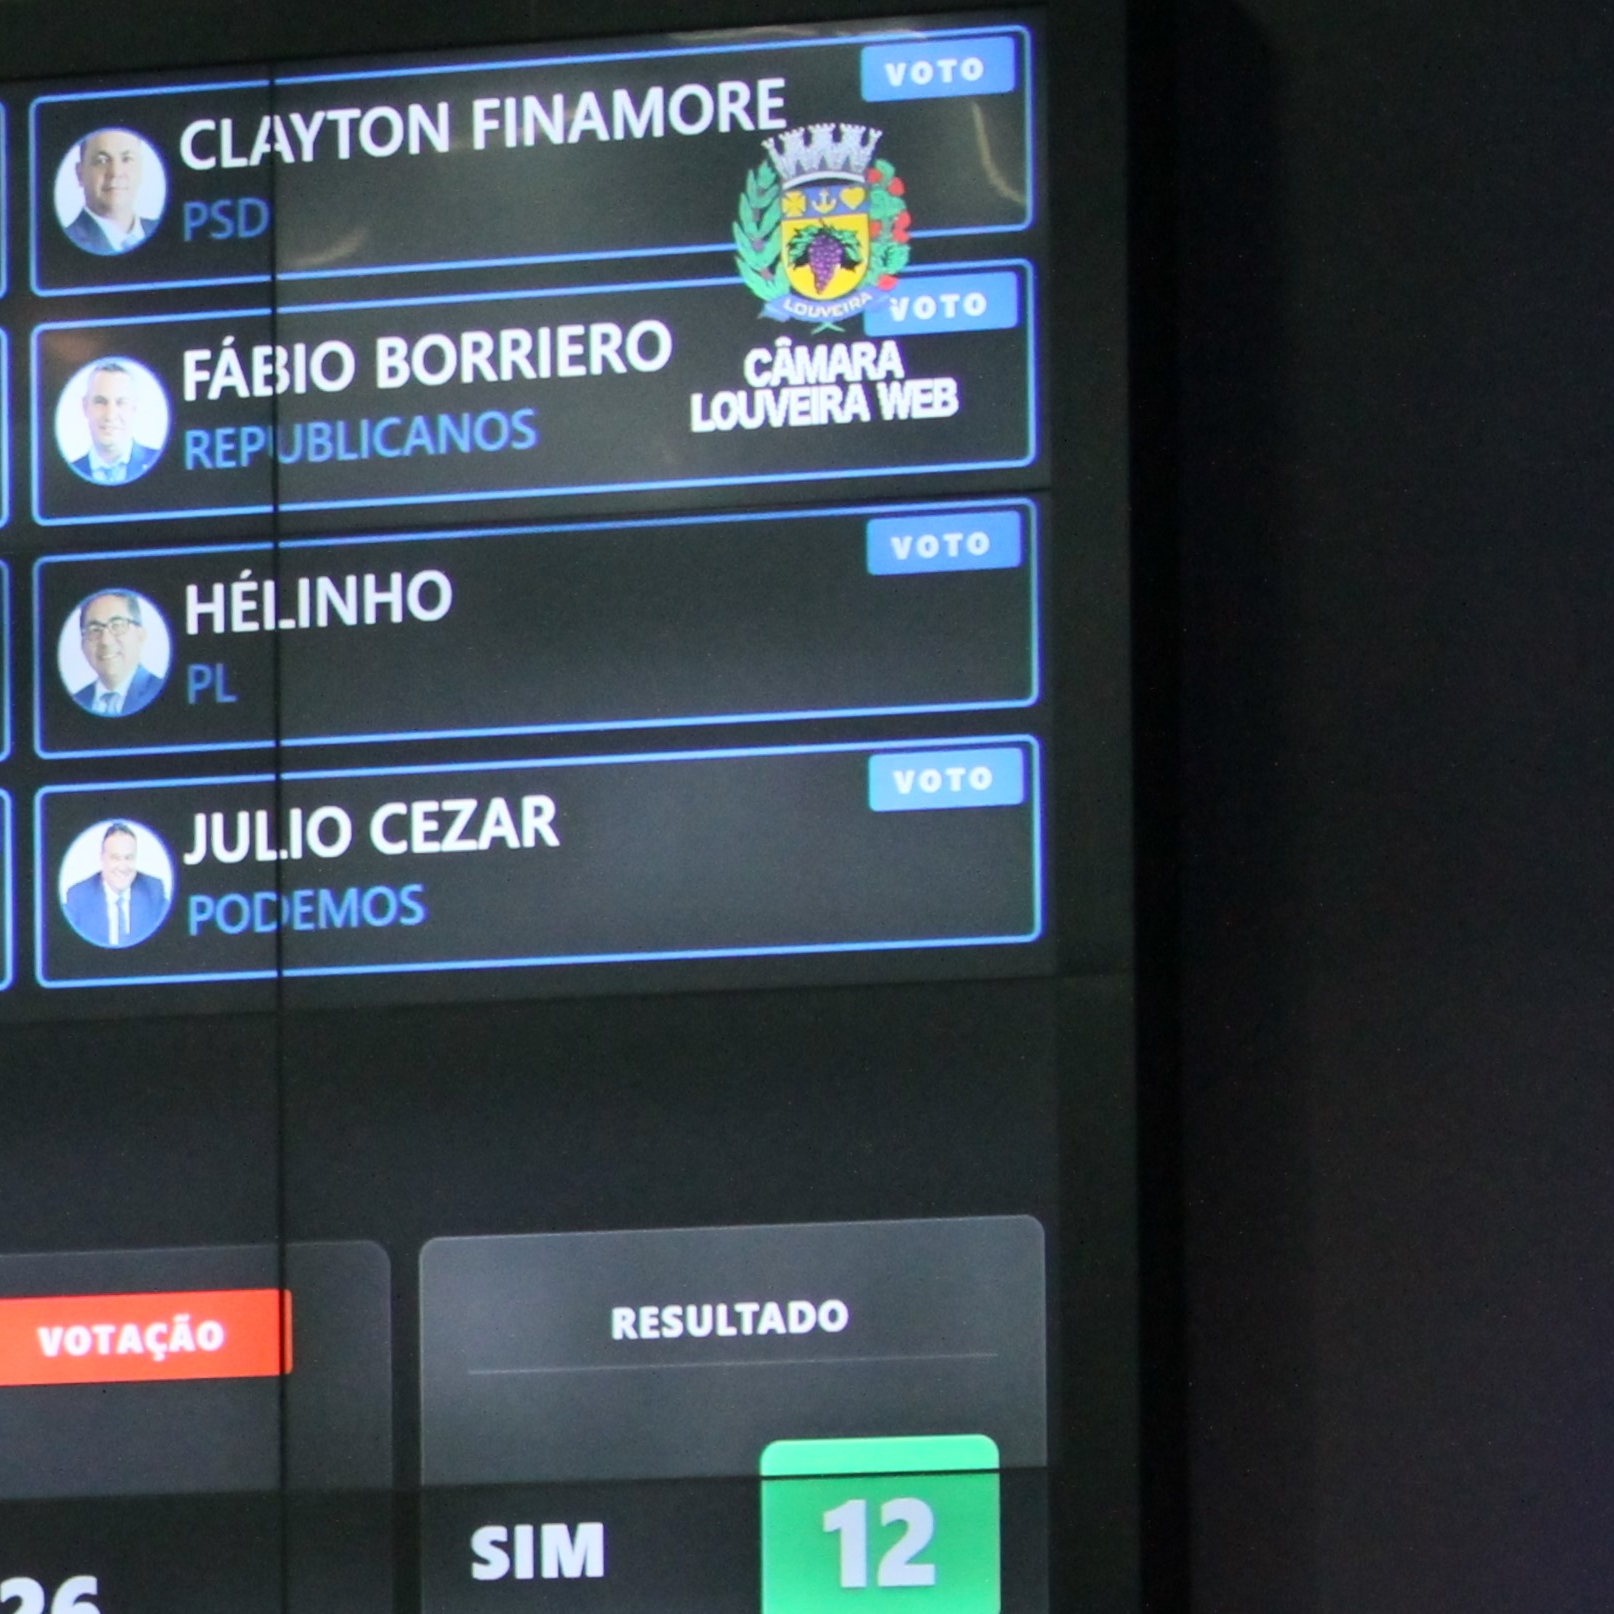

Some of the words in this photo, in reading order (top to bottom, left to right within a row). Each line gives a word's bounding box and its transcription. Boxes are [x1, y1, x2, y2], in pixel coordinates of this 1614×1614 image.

[885, 58, 983, 87] VOTO
[180, 101, 450, 171] CLAYTON
[472, 78, 787, 151] FINAMORE
[183, 200, 269, 242] PSD
[783, 292, 873, 317] LOUVEIRA
[888, 292, 986, 321] VOTO
[183, 338, 356, 401] FÁBIO
[376, 320, 672, 391] BORRIERO
[743, 336, 904, 387] CÂMARA
[690, 384, 870, 432] LOUVEIRA
[877, 378, 959, 420] WEB
[185, 409, 537, 470] REPUBLICANOS
[890, 532, 988, 560] VOTO
[186, 570, 452, 635] HÉLINHO
[189, 664, 236, 704] PL
[893, 765, 991, 796] VOTO
[184, 802, 352, 866] JULIO
[371, 795, 560, 857] CEZAR
[189, 884, 424, 936] PODEMOS
[38, 1315, 224, 1363] VOTAÇÃO
[611, 1300, 848, 1340] RESULTADO
[471, 1522, 604, 1581] SIM
[822, 1497, 936, 1588] 12
